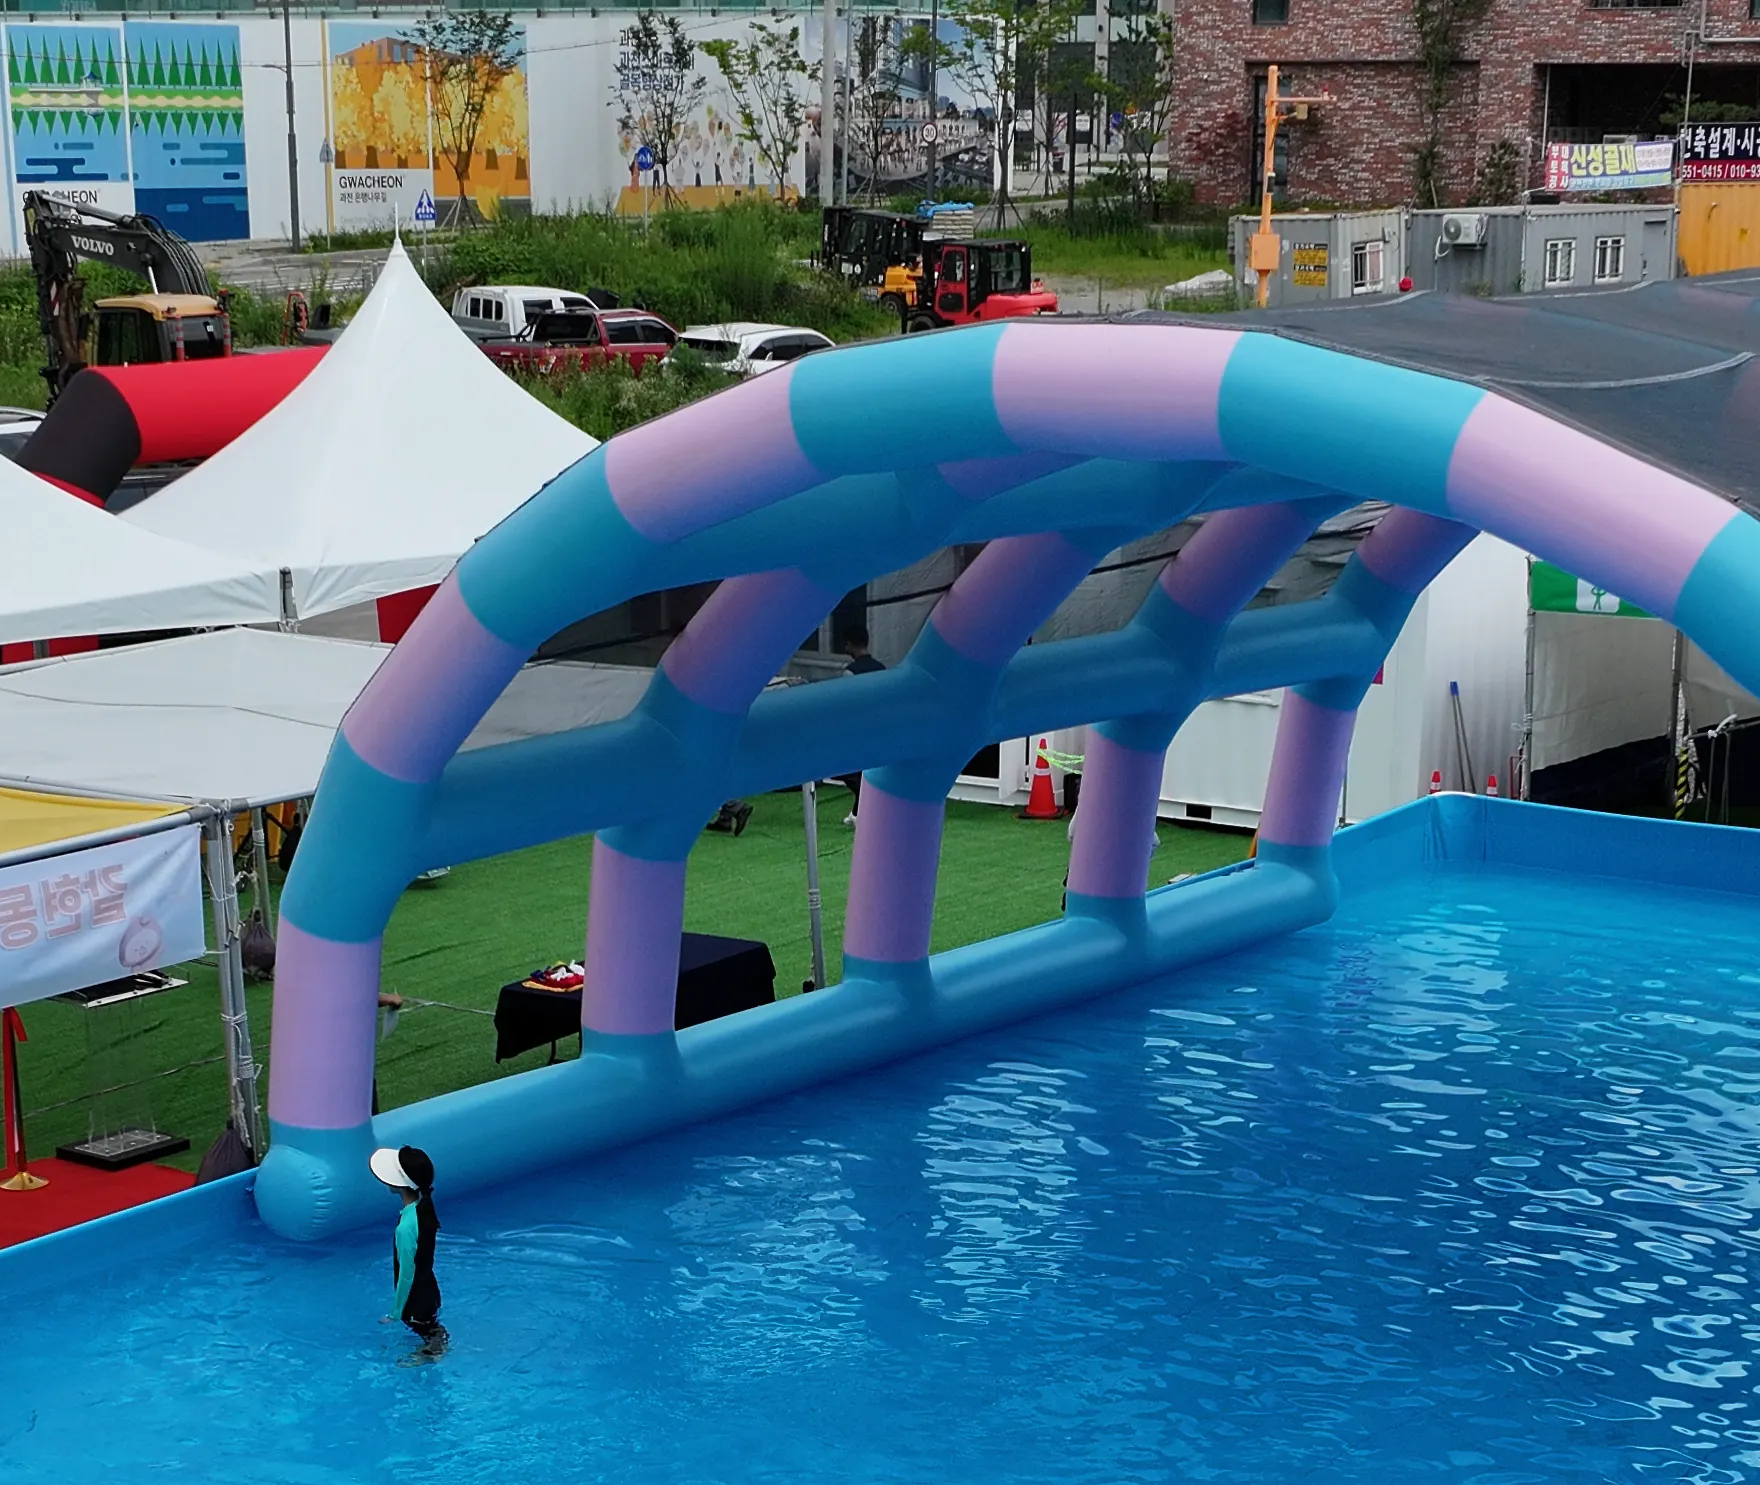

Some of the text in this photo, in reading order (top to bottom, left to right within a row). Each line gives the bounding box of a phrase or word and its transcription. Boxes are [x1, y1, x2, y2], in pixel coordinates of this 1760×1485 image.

[1571, 143, 1637, 176] 신성골재
[339, 175, 403, 189] GWACHEON
[71, 234, 115, 256] VOLVO
